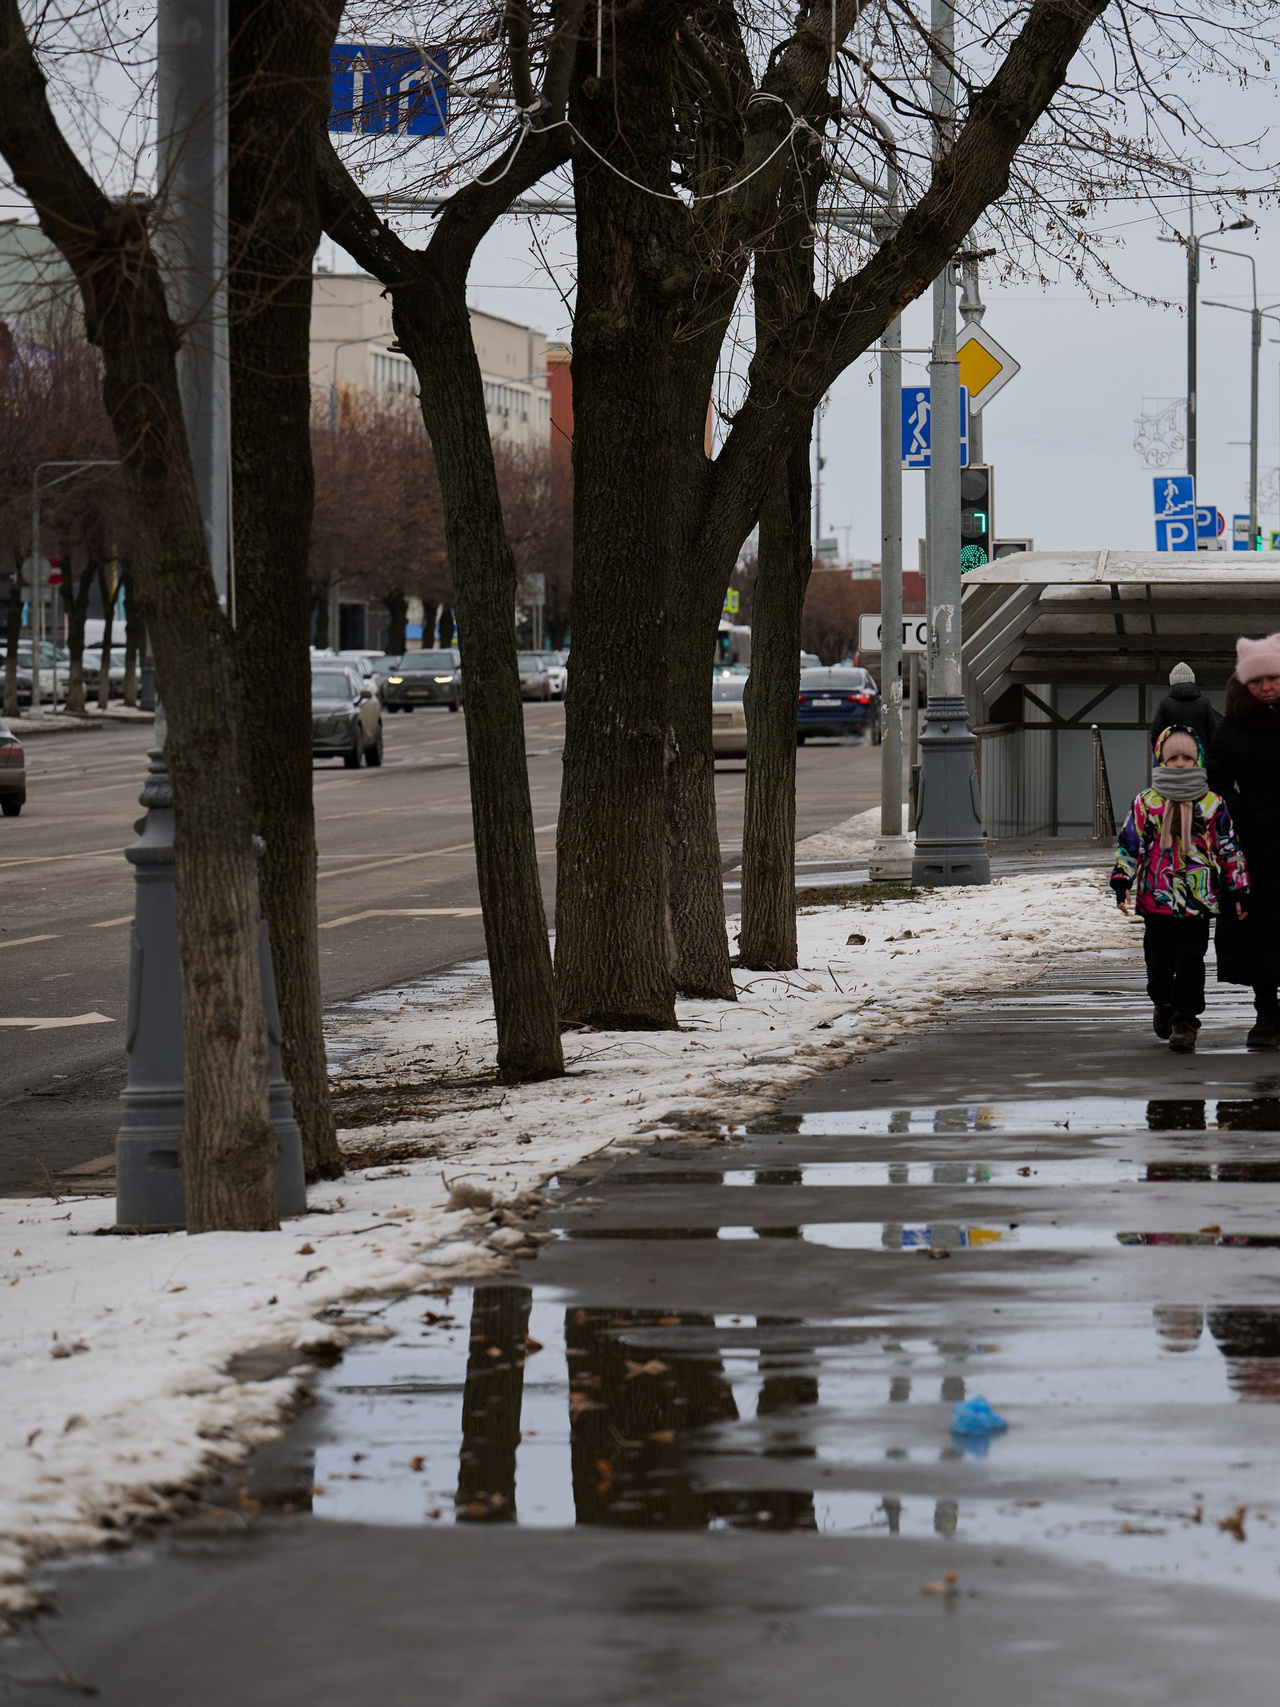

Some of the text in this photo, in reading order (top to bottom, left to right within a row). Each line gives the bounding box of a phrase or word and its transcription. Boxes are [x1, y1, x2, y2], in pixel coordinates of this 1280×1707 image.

[974, 513, 986, 533] 7
[1166, 522, 1189, 551] P
[877, 622, 928, 645] ТО
